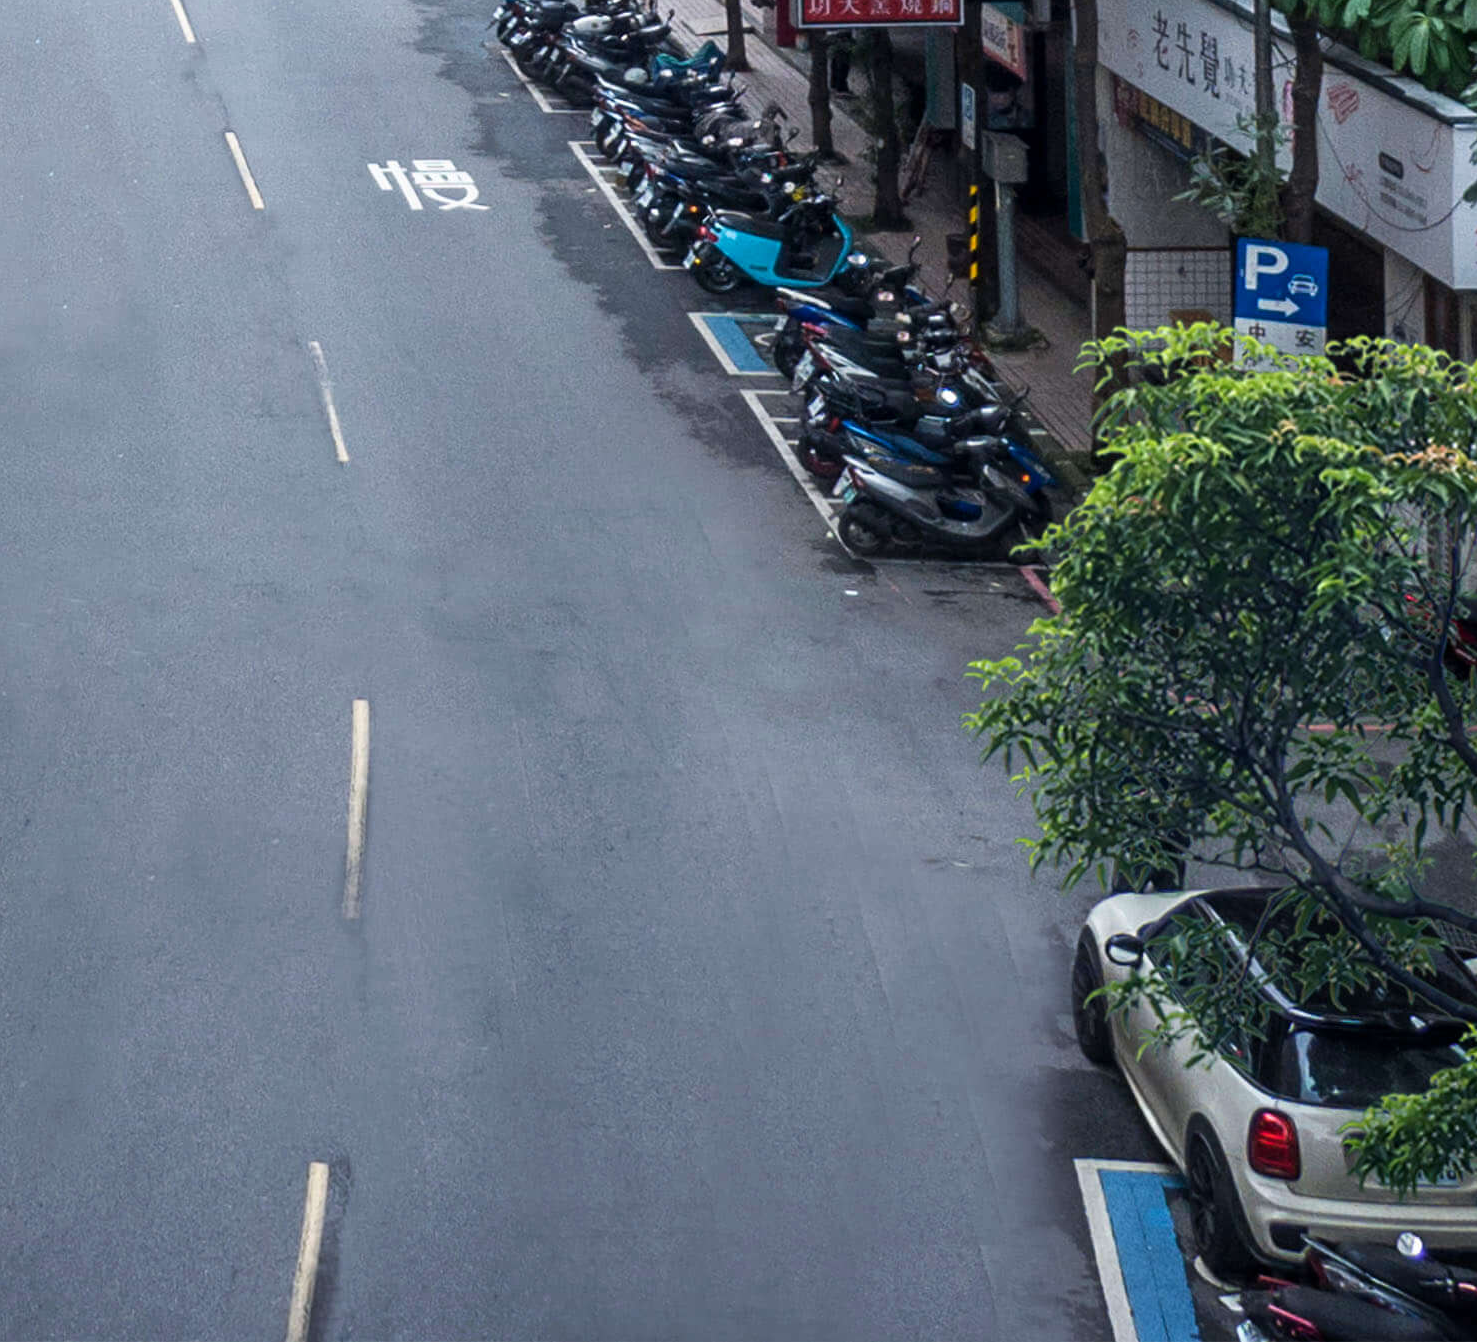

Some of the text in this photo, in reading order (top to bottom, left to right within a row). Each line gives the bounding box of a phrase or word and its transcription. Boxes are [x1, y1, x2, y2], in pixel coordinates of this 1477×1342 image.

[1152, 9, 1220, 100] 老先覺
[367, 159, 490, 211] 慢
[1245, 244, 1289, 290] P
